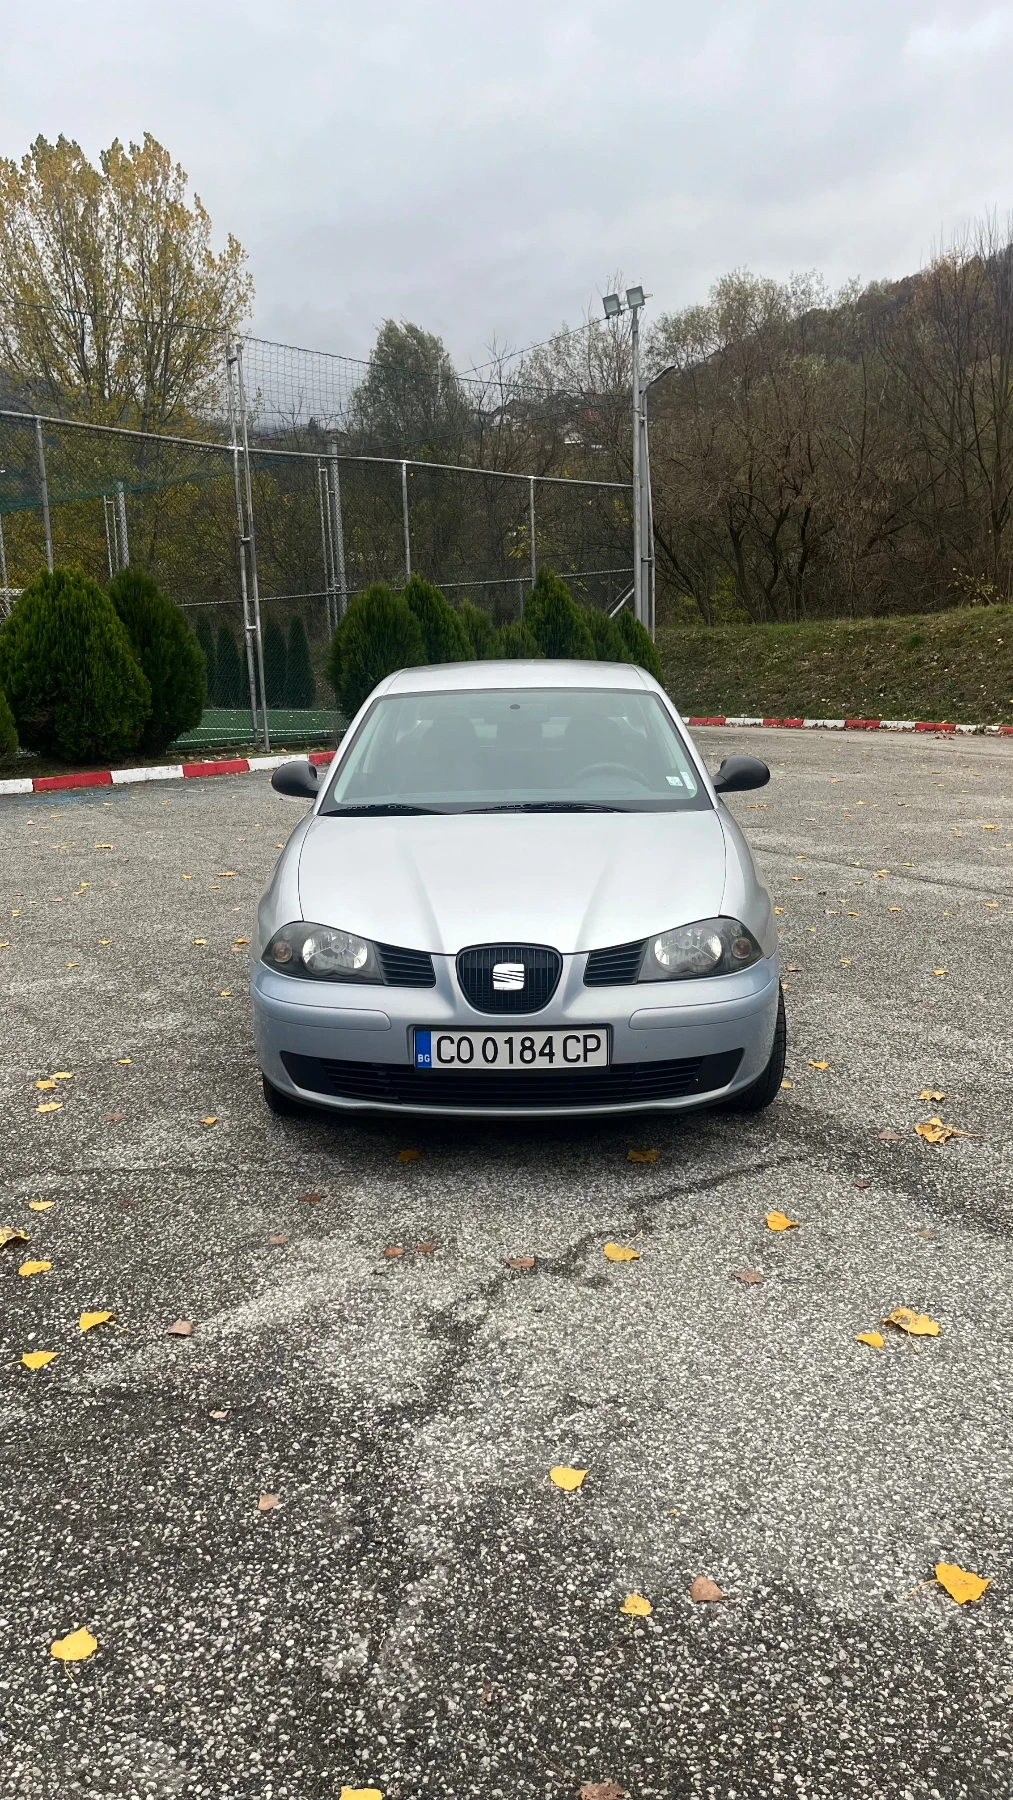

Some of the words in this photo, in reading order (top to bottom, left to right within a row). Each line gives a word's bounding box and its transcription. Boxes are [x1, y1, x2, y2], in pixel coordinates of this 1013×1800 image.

[417, 1054, 430, 1063] BG
[436, 1035, 474, 1064] CO
[482, 1035, 555, 1064] 0184
[562, 1034, 601, 1063] CP
